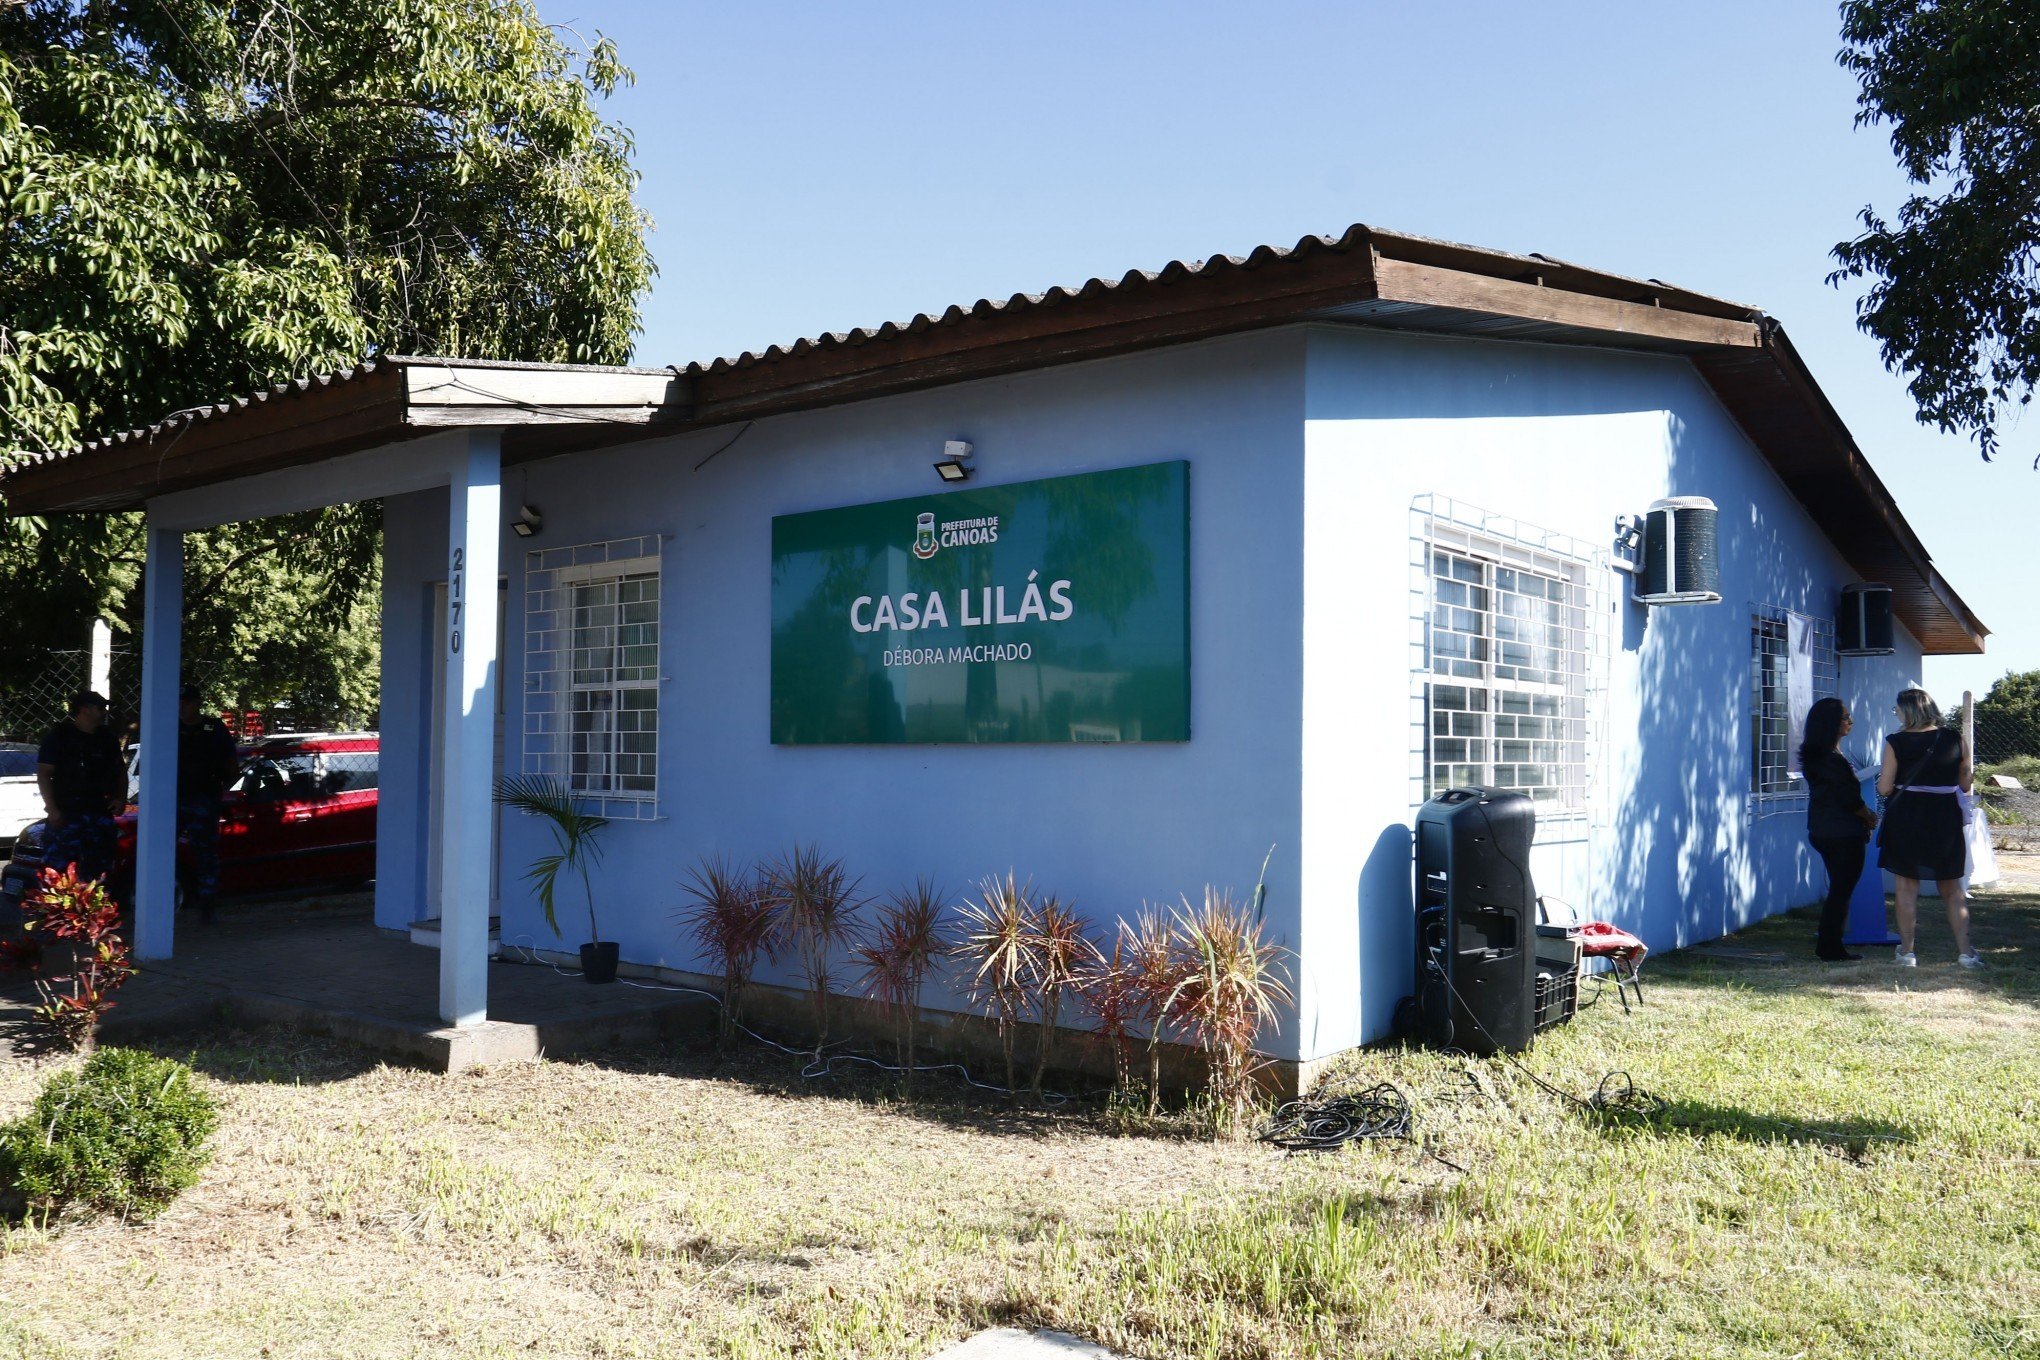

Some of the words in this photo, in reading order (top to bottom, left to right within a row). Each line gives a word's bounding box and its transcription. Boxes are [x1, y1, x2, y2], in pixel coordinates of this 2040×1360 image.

[941, 518, 986, 531] PREFEITURA
[987, 516, 999, 526] DE
[941, 526, 998, 547] CANOAS
[451, 548, 463, 653] 2170
[850, 591, 949, 633] CASA
[960, 569, 1073, 626] LILÁS
[883, 645, 944, 666] DÉBORA
[948, 642, 1032, 663] MACHADO
